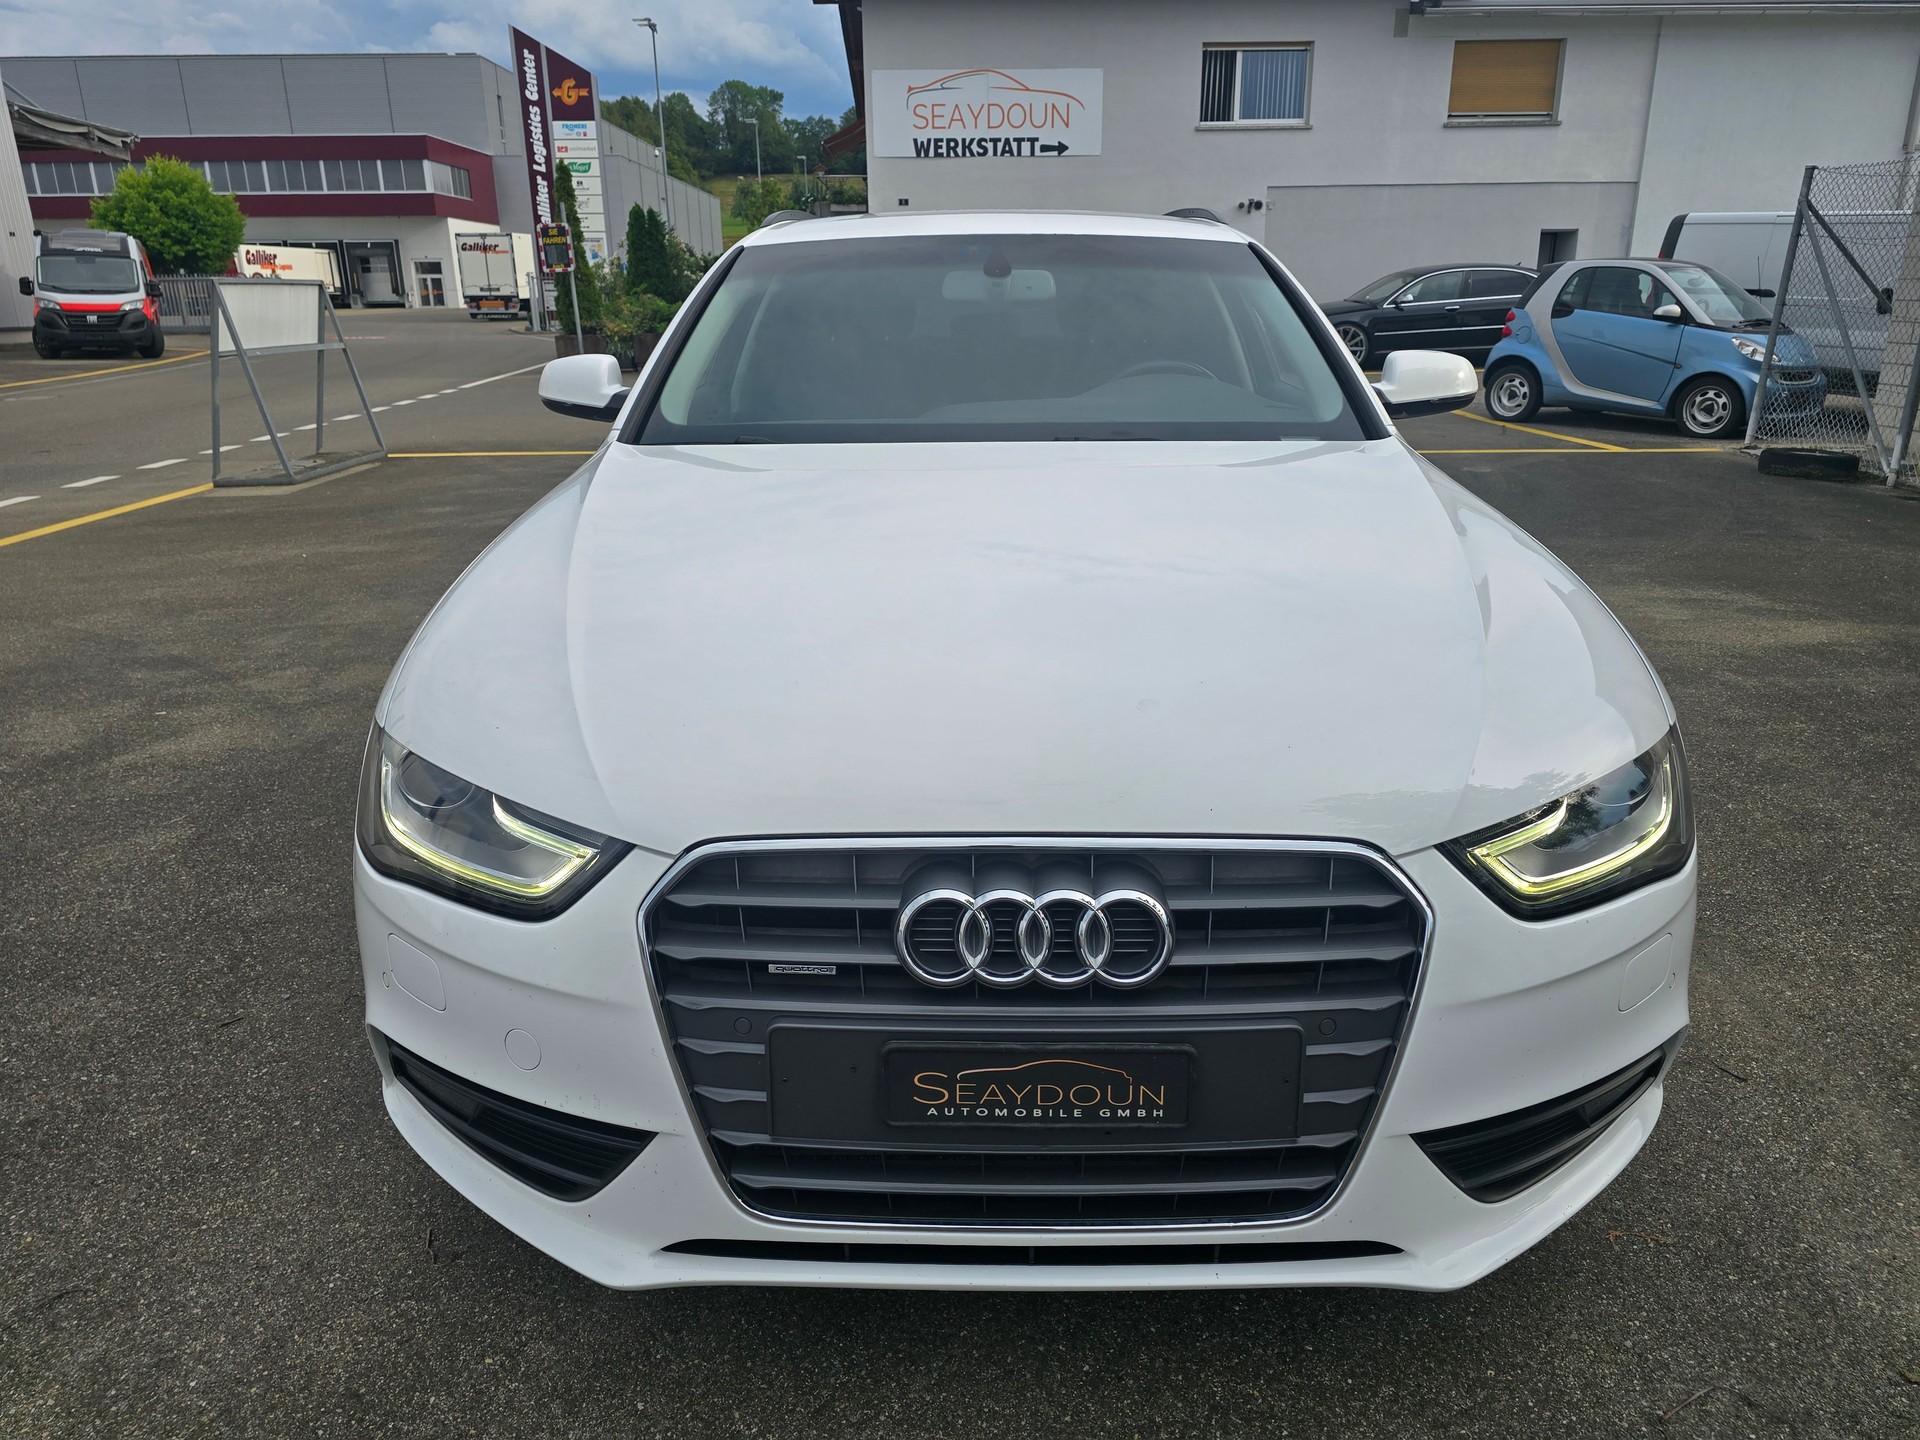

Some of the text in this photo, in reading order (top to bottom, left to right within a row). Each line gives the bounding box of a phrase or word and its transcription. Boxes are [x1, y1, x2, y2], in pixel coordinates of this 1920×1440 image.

[912, 102, 1070, 130] SEAYDOUN
[523, 49, 551, 224] alliker Logistics Center
[913, 137, 1039, 157] WERKSTATT
[543, 236, 566, 244] FAHREN
[548, 228, 558, 236] SIE
[461, 242, 499, 252] Galliker
[245, 249, 277, 265] Galliker
[912, 1071, 1165, 1106] SEAYDOUN
[926, 1107, 1164, 1118] AUTOMOBILE GMBH
